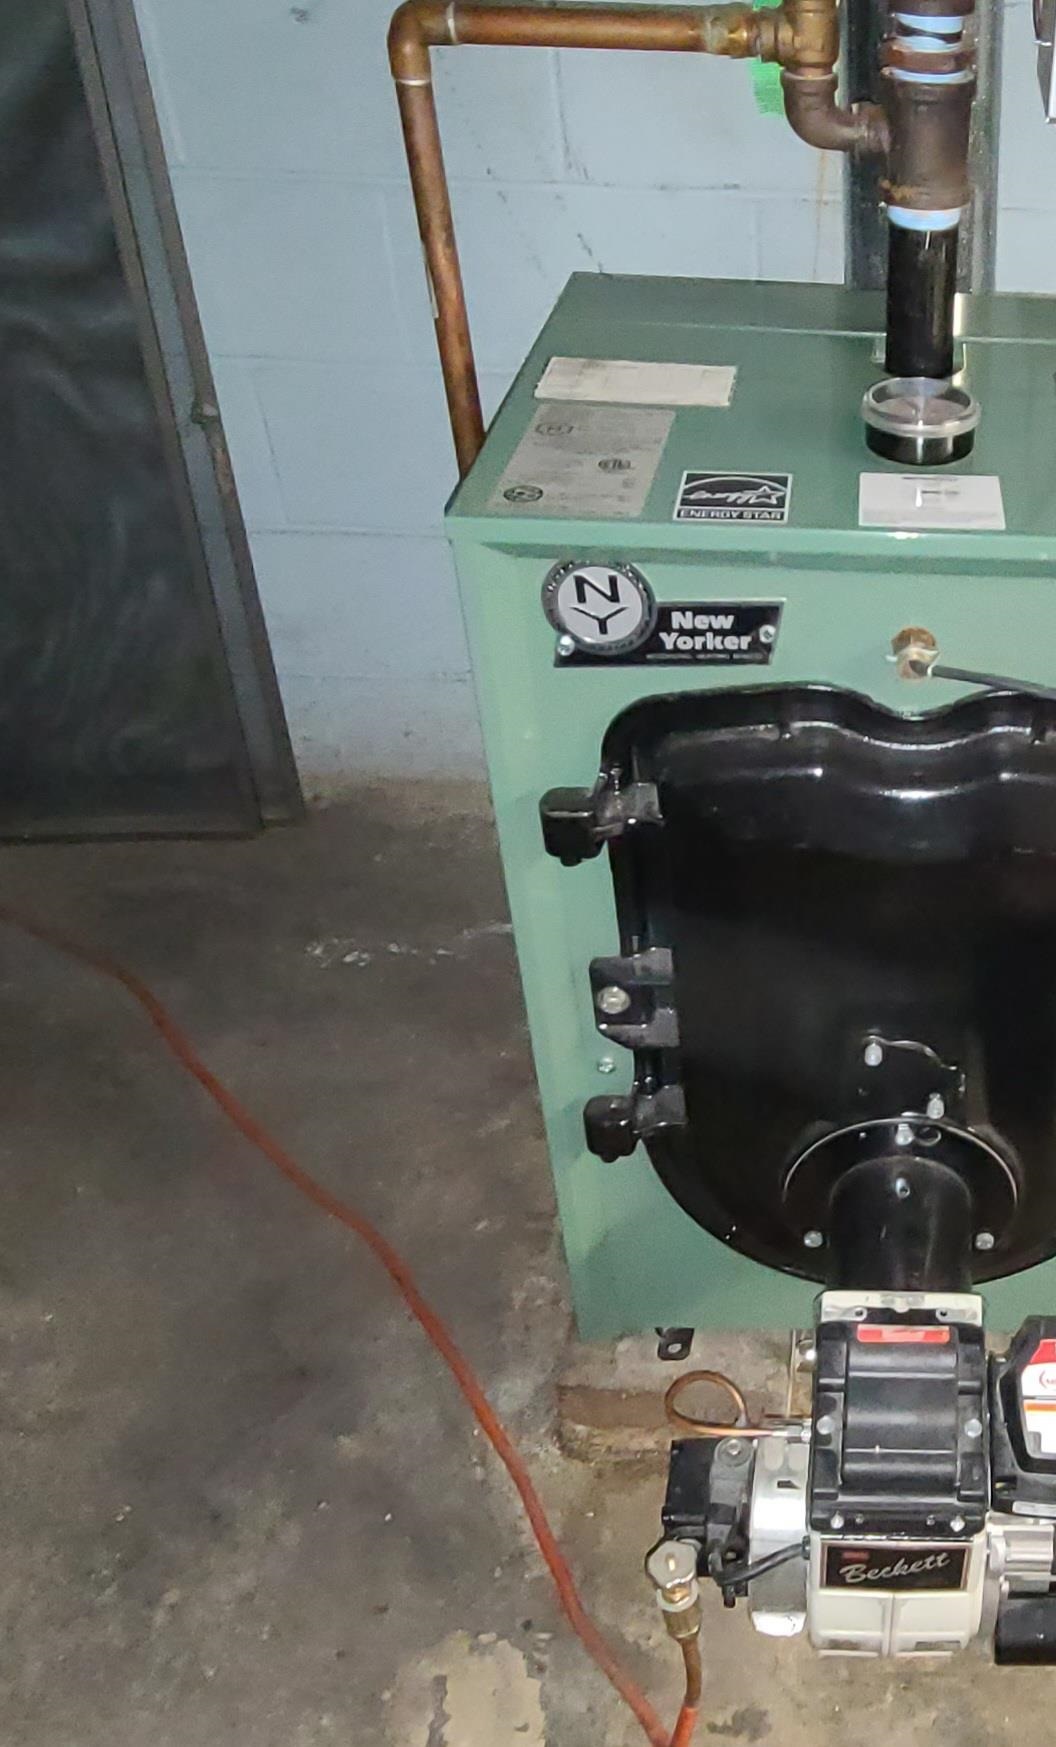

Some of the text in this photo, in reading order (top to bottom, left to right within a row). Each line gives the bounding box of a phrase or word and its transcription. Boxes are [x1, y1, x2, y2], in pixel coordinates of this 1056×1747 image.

[679, 509, 782, 520] ENERGY STAR
[670, 610, 735, 630] New
[658, 631, 753, 651] Yorker
[838, 1551, 952, 1584] Beckett
